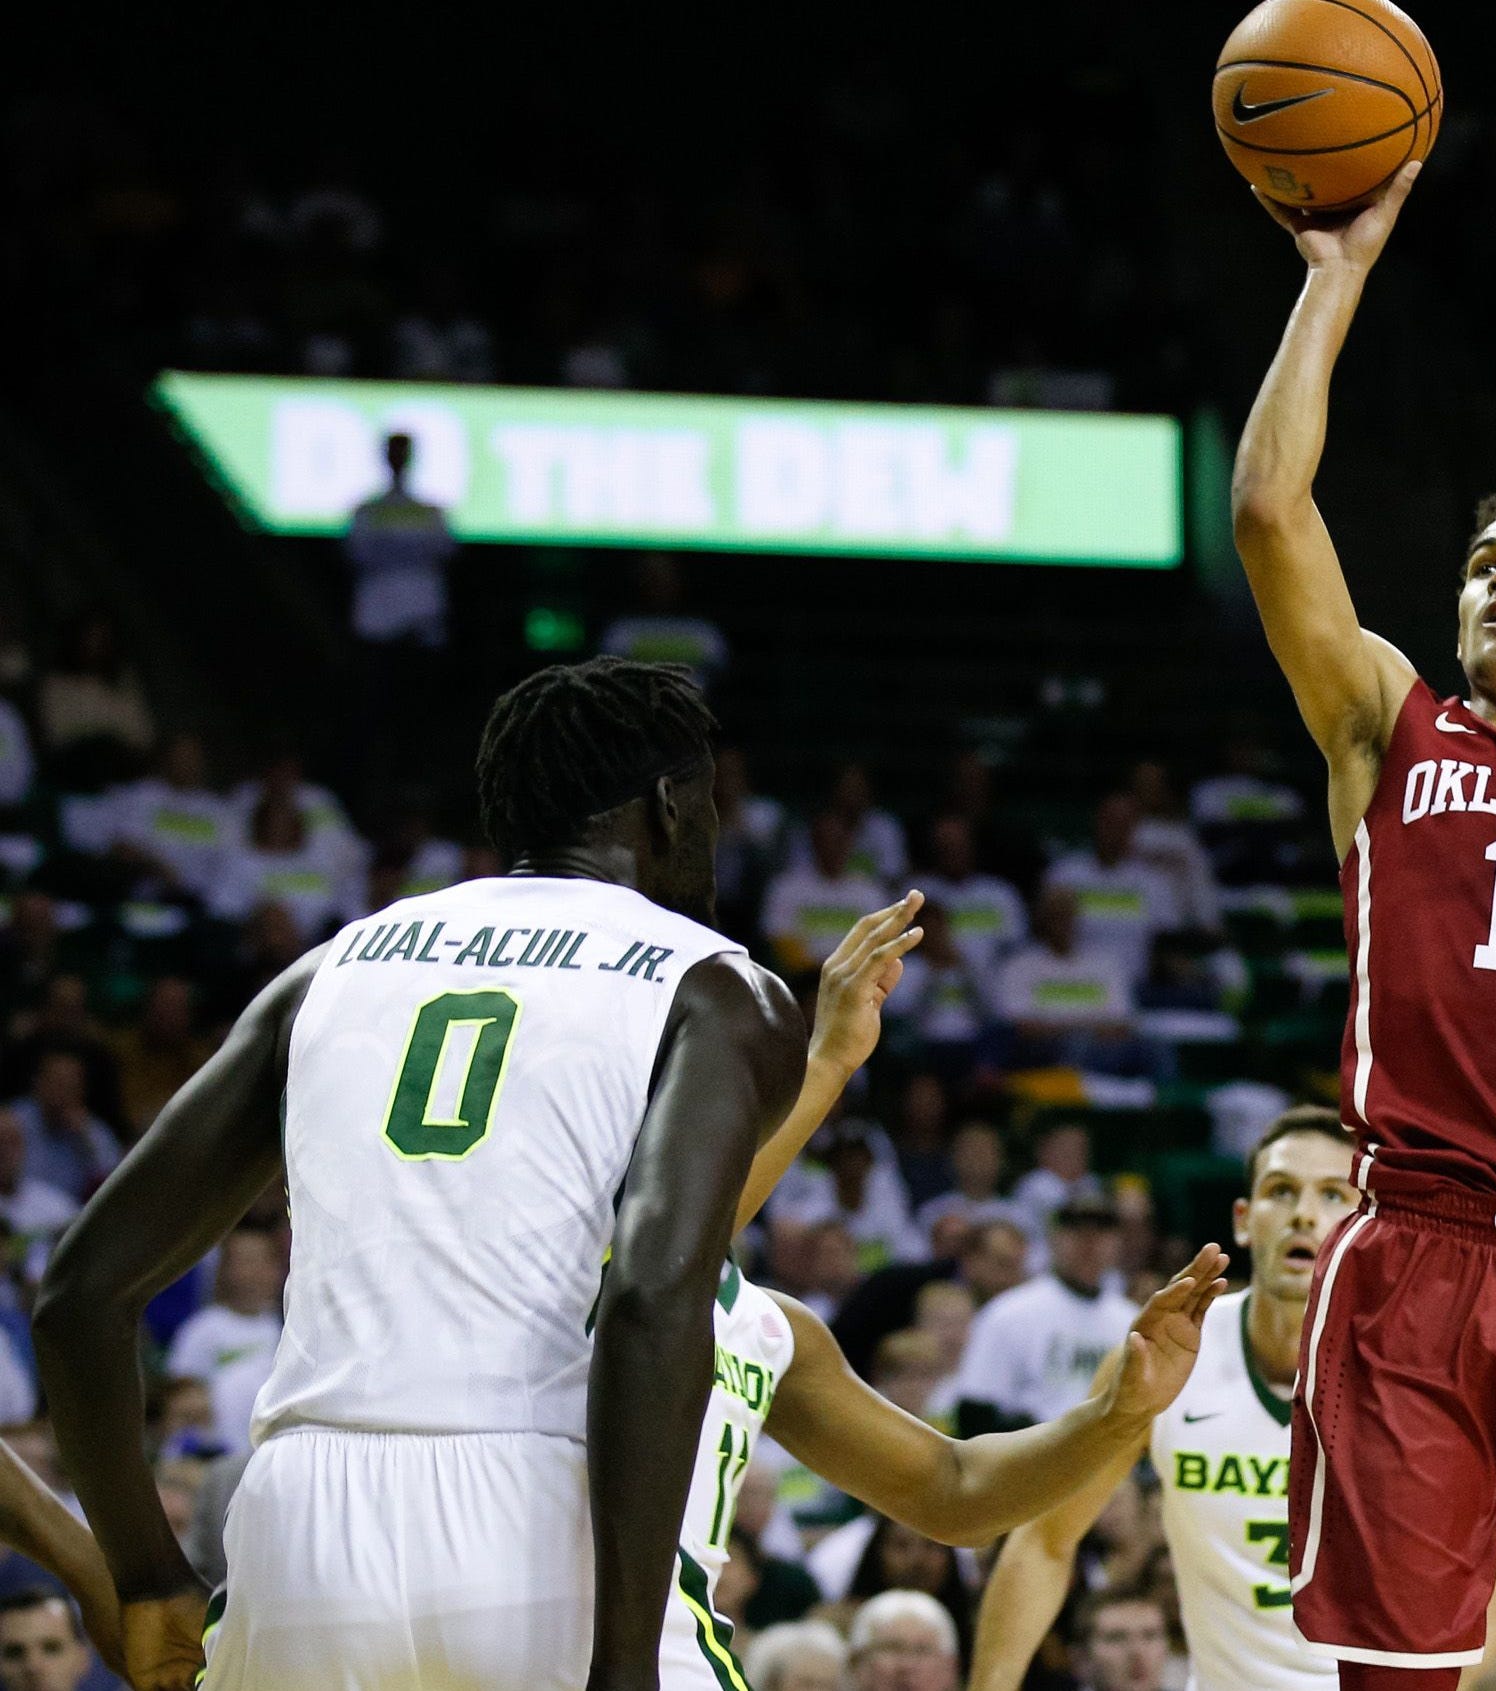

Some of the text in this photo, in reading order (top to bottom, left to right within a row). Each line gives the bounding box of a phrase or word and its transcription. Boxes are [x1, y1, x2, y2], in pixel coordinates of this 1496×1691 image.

[492, 423, 716, 526] THE
[737, 414, 1019, 542] DEW
[335, 921, 674, 983] LUAL-ACUIL JR.
[379, 986, 526, 1162] 0
[1174, 1452, 1290, 1497] BAY
